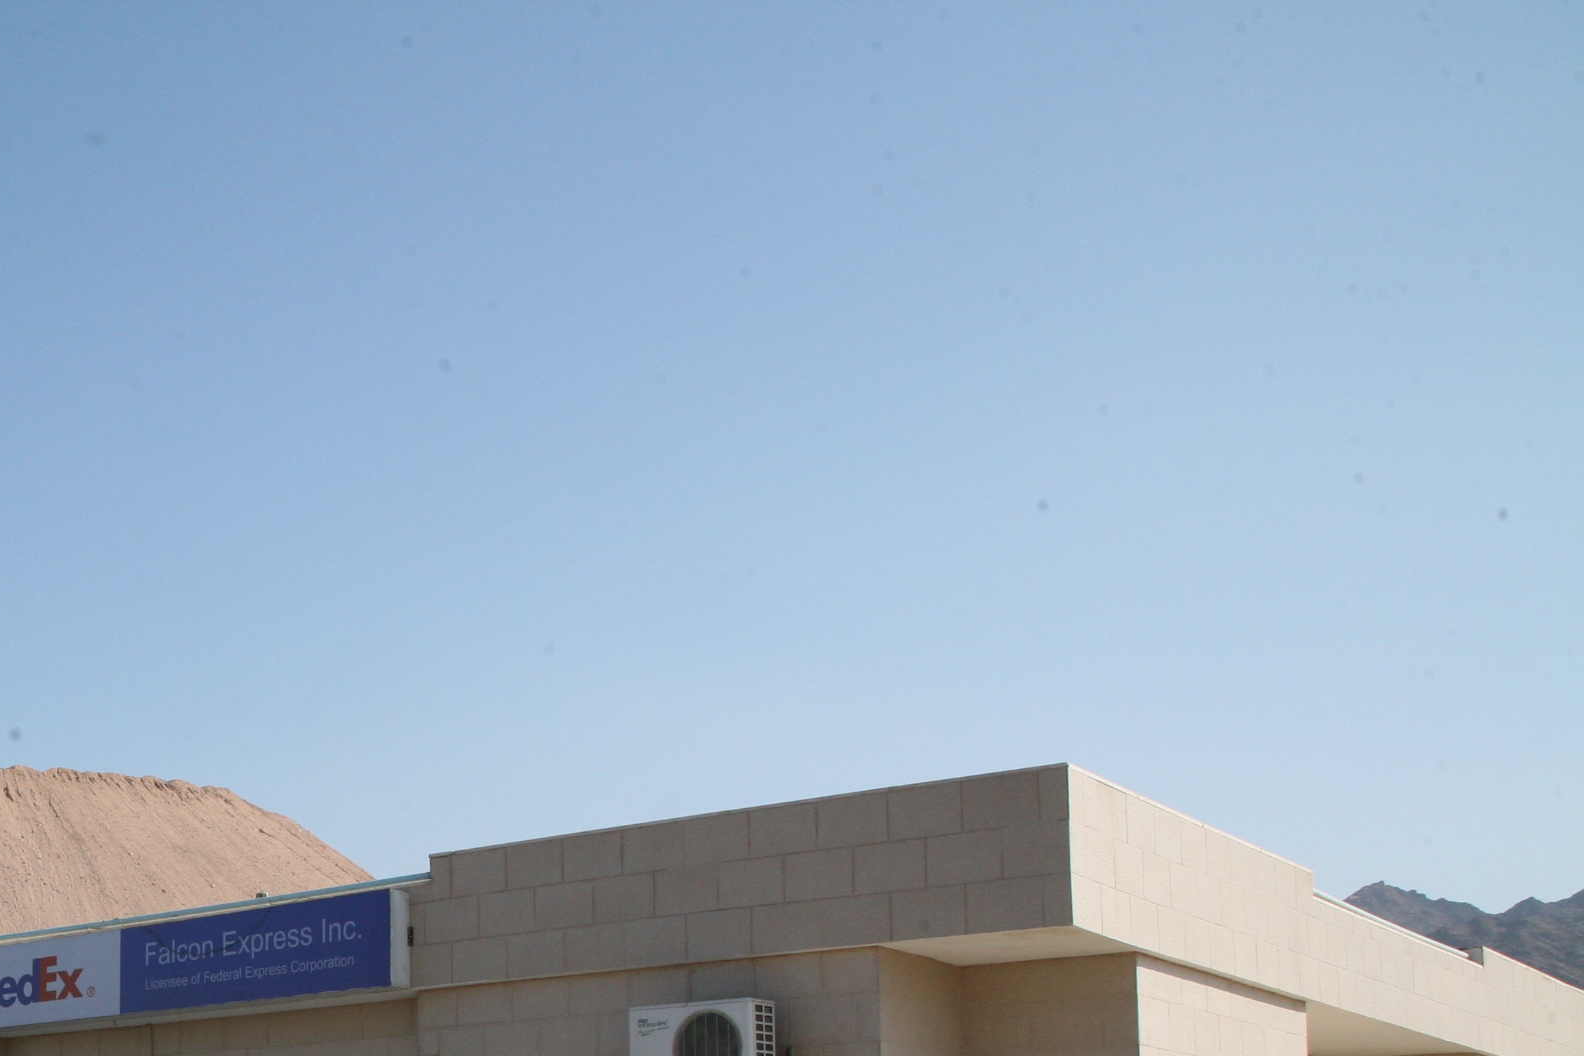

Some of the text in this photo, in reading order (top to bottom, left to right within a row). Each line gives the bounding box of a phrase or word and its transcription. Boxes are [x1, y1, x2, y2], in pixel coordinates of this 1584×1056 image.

[145, 918, 362, 966] Falcon Express Inc.
[144, 955, 355, 991] Licensee of Federal Express Corporation
